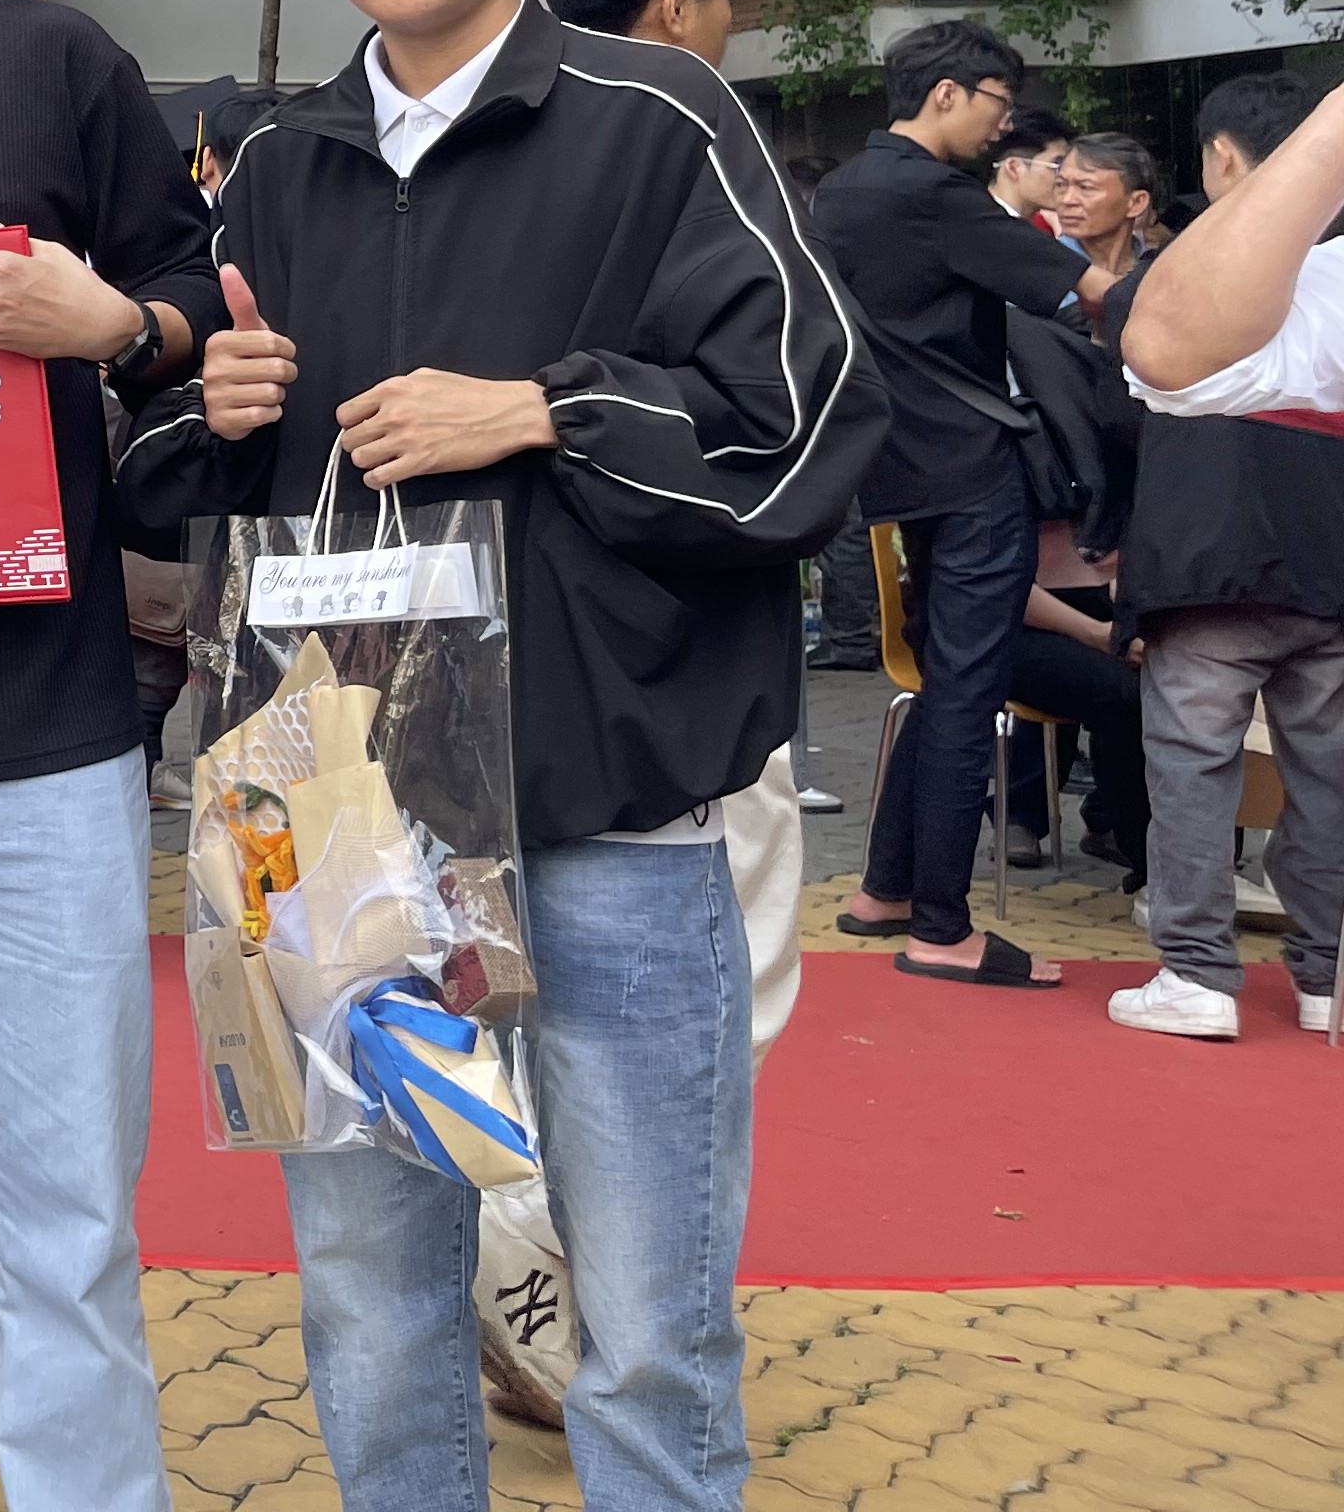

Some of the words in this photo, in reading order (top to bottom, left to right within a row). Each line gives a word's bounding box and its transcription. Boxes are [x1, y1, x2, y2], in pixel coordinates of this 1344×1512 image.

[259, 560, 299, 595] You
[302, 574, 327, 587] are
[330, 570, 355, 592] my
